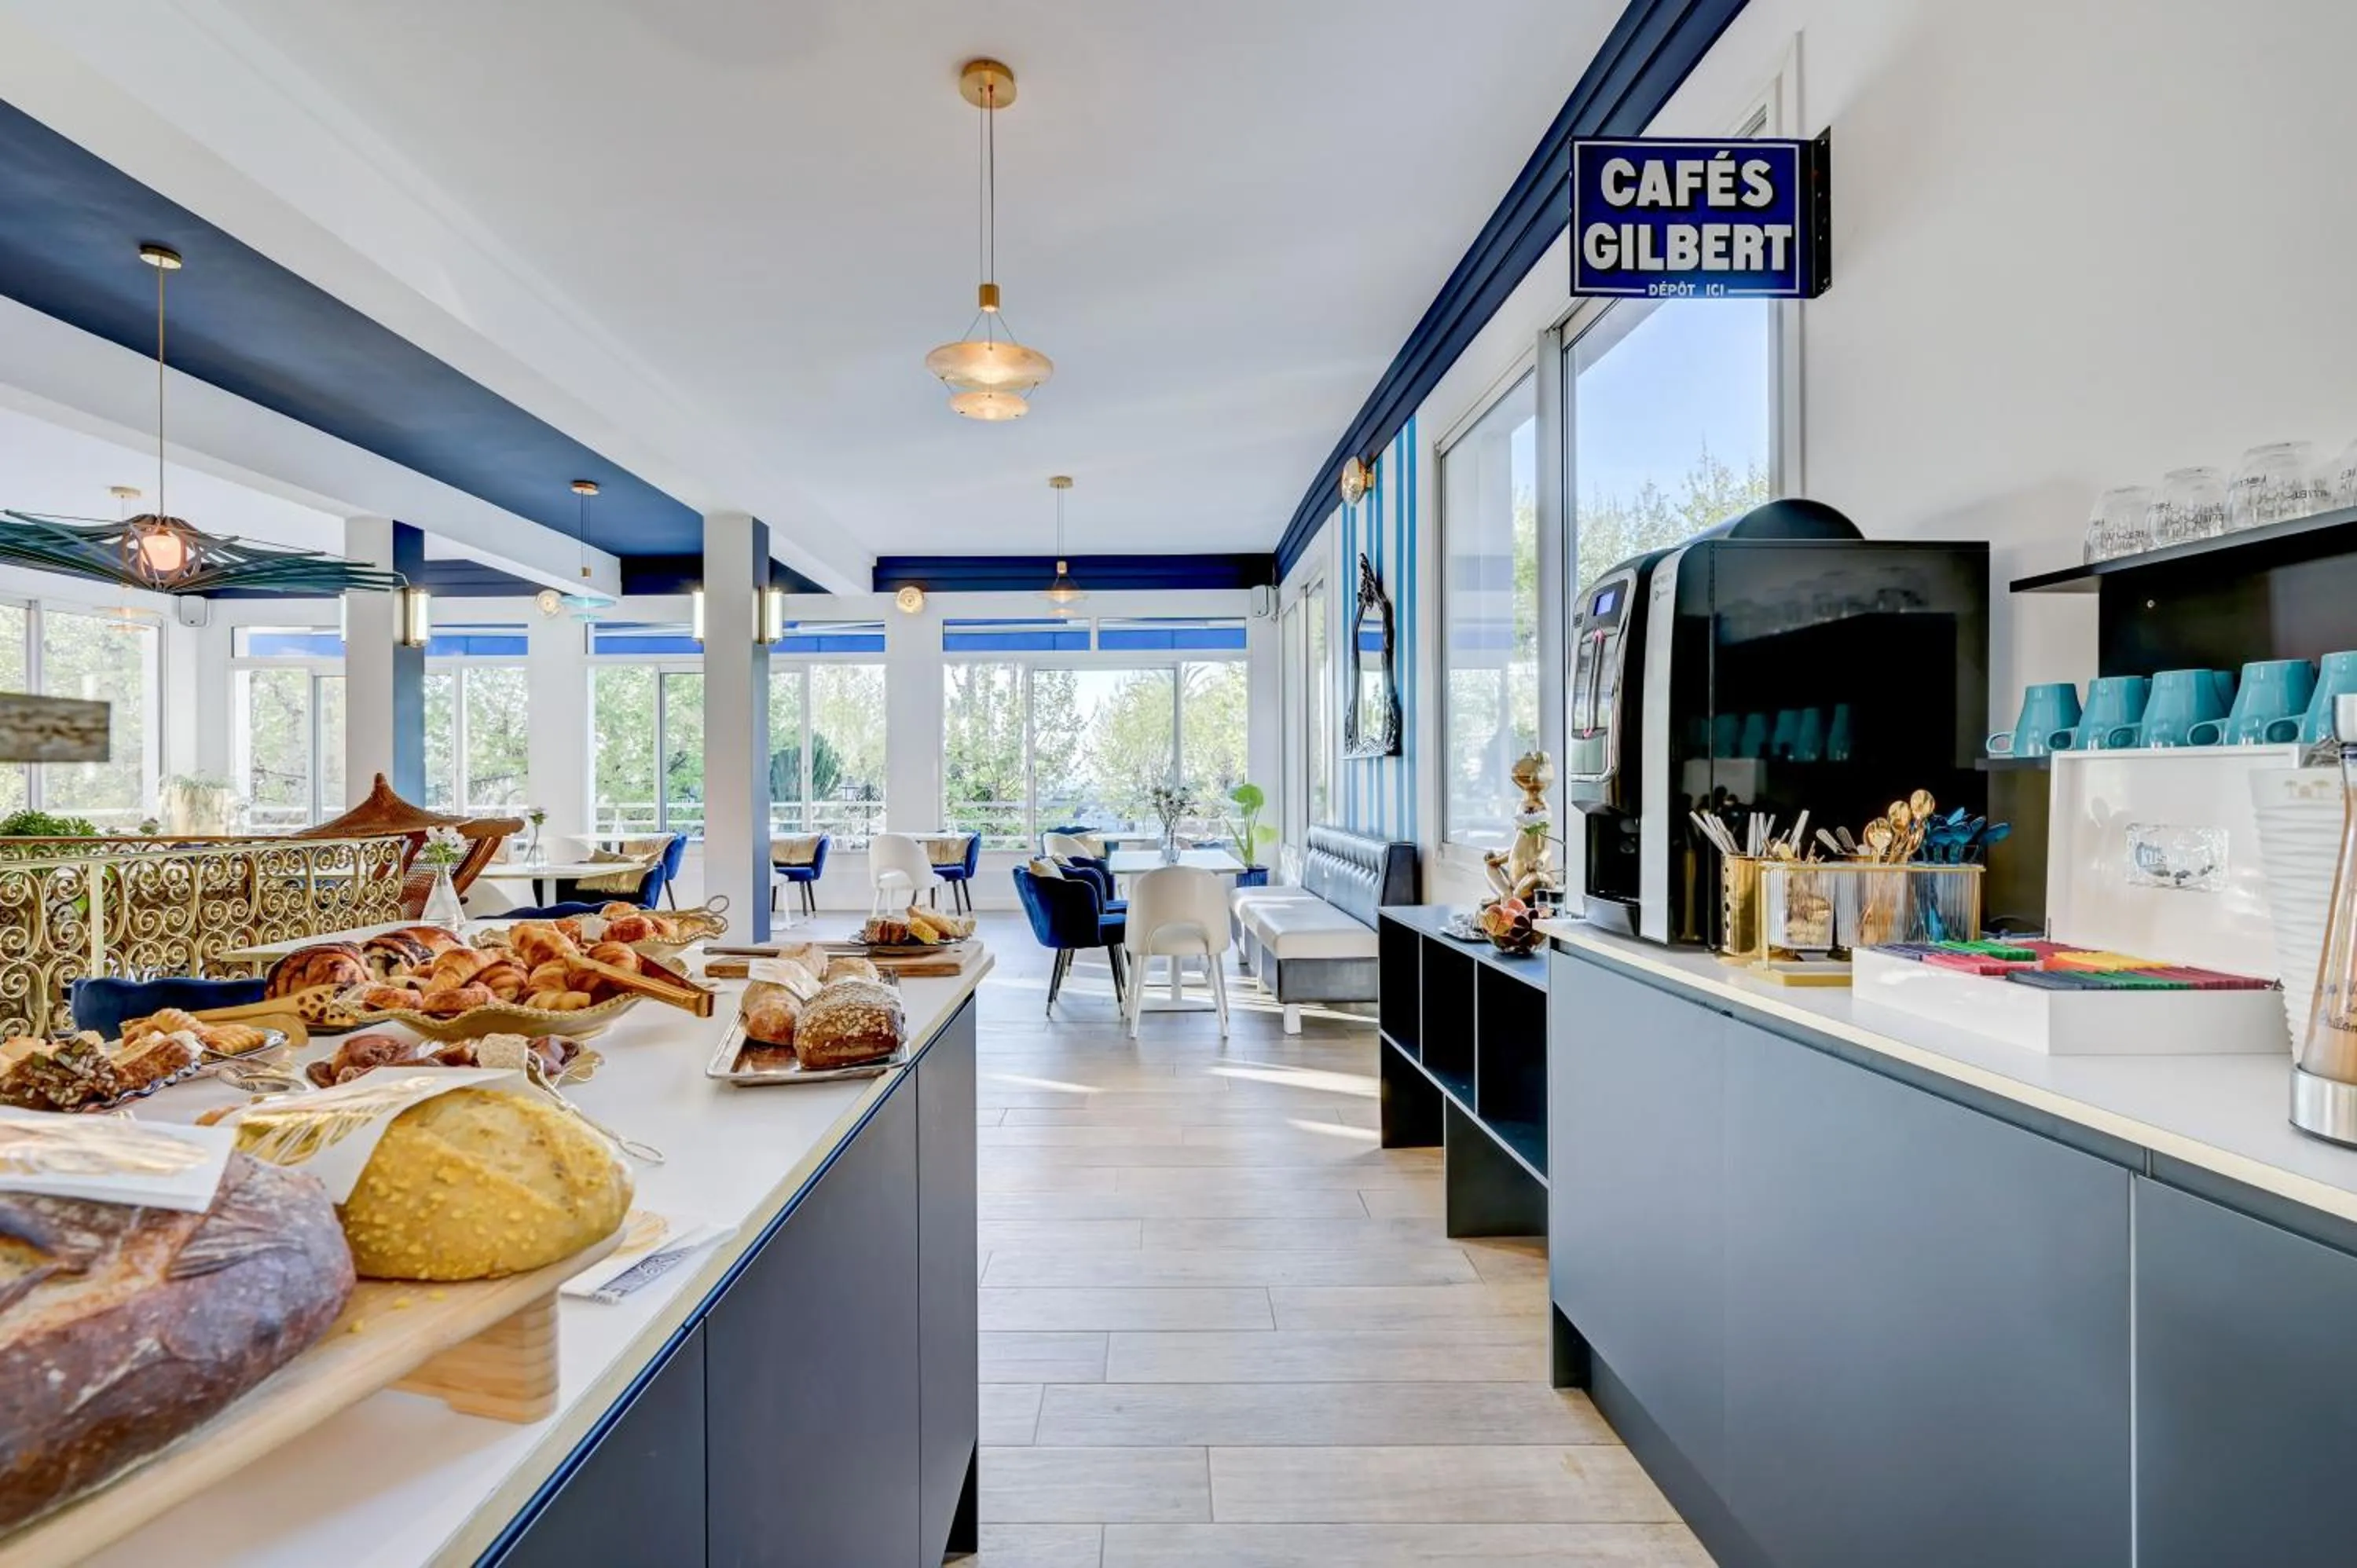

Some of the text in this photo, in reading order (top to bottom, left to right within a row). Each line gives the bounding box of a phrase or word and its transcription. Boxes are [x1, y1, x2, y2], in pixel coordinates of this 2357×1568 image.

[1600, 150, 1773, 207] CAFÉS
[1583, 222, 1792, 271] GILBERT
[1648, 280, 1725, 296] DÉPÔT ICI
